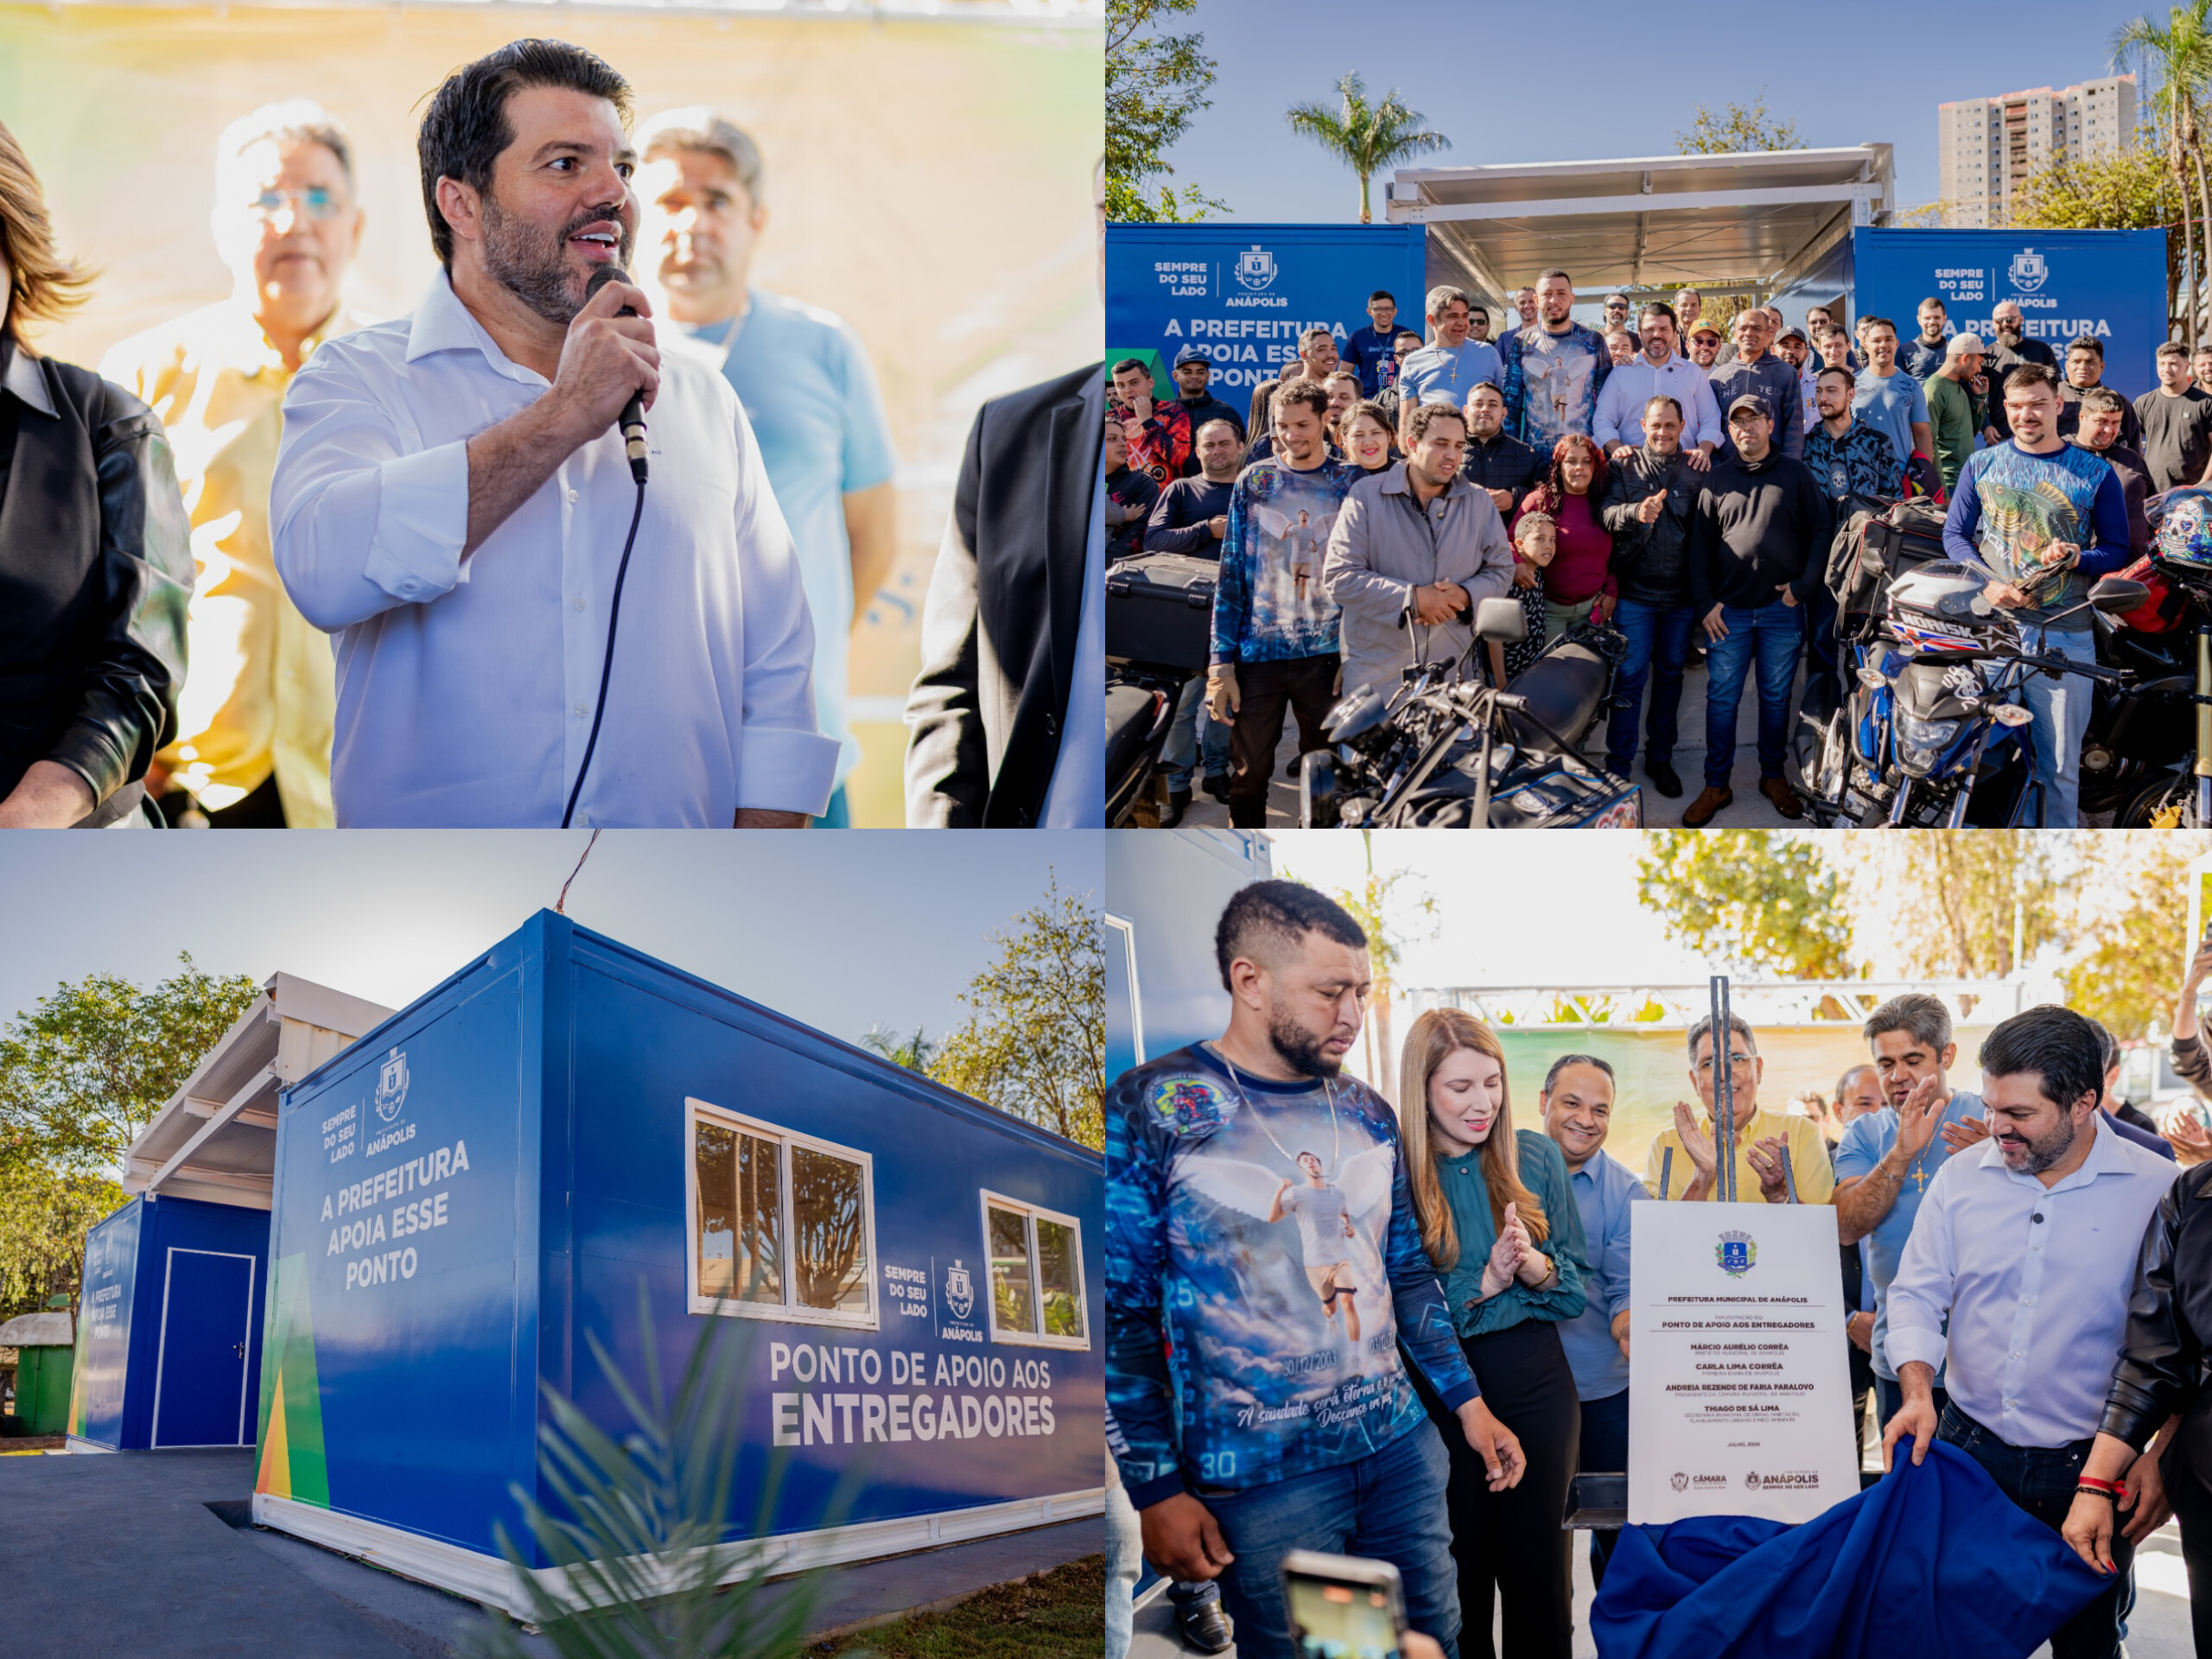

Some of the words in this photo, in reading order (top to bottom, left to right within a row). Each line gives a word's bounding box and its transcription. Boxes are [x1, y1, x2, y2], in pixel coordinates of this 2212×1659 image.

[1154, 262, 1207, 272] SEMPRE
[1935, 269, 1984, 278] SEMPRE
[1159, 274, 1178, 283] DO
[1181, 275, 1207, 284] SEU
[1939, 280, 1957, 289] DO
[1960, 280, 1984, 289] SEU
[1172, 286, 1206, 296] LADO
[1950, 291, 1984, 301] LADO
[1225, 296, 1288, 307] ANÁPOLIS
[1164, 318, 1183, 337] A
[1942, 320, 1958, 337] A
[1965, 319, 2112, 337] PREITURA
[1208, 368, 1281, 386] PONT
[1900, 613, 1975, 639] NORISK
[321, 1104, 357, 1135] SEMPRE
[324, 1133, 336, 1150] DO
[338, 1122, 355, 1143] SEU
[365, 1123, 416, 1158] ANÁPOLIS
[331, 1141, 355, 1164] LADO
[321, 1194, 334, 1223] A
[338, 1139, 470, 1217] PREFEITURA
[327, 1213, 386, 1256] APOIA
[391, 1192, 448, 1238] ESSE
[346, 1247, 417, 1290] PONTO
[885, 1264, 926, 1284] SEMPRE
[889, 1283, 905, 1297] DO
[906, 1286, 926, 1301] SEU
[900, 1302, 928, 1318] LADO
[942, 1325, 983, 1343] ANÁPOLIS
[770, 1342, 882, 1385] PONTO
[891, 1351, 926, 1386] DE
[934, 1354, 1006, 1389] APOIO
[1012, 1359, 1052, 1389] AOS
[1749, 1362, 1784, 1370] CORRÊA
[1237, 1404, 1255, 1427] A
[1258, 1398, 1311, 1423] saudade
[1313, 1389, 1341, 1413] será
[1342, 1382, 1376, 1404] eterna
[1316, 1402, 1368, 1428] Descanse
[1369, 1396, 1381, 1411] em
[772, 1392, 1056, 1447] ENTREGADORES
[1199, 1450, 1236, 1480] 30
[1693, 1474, 1727, 1483] CÂMARA
[1763, 1472, 1819, 1484] ANÁPOLIS
